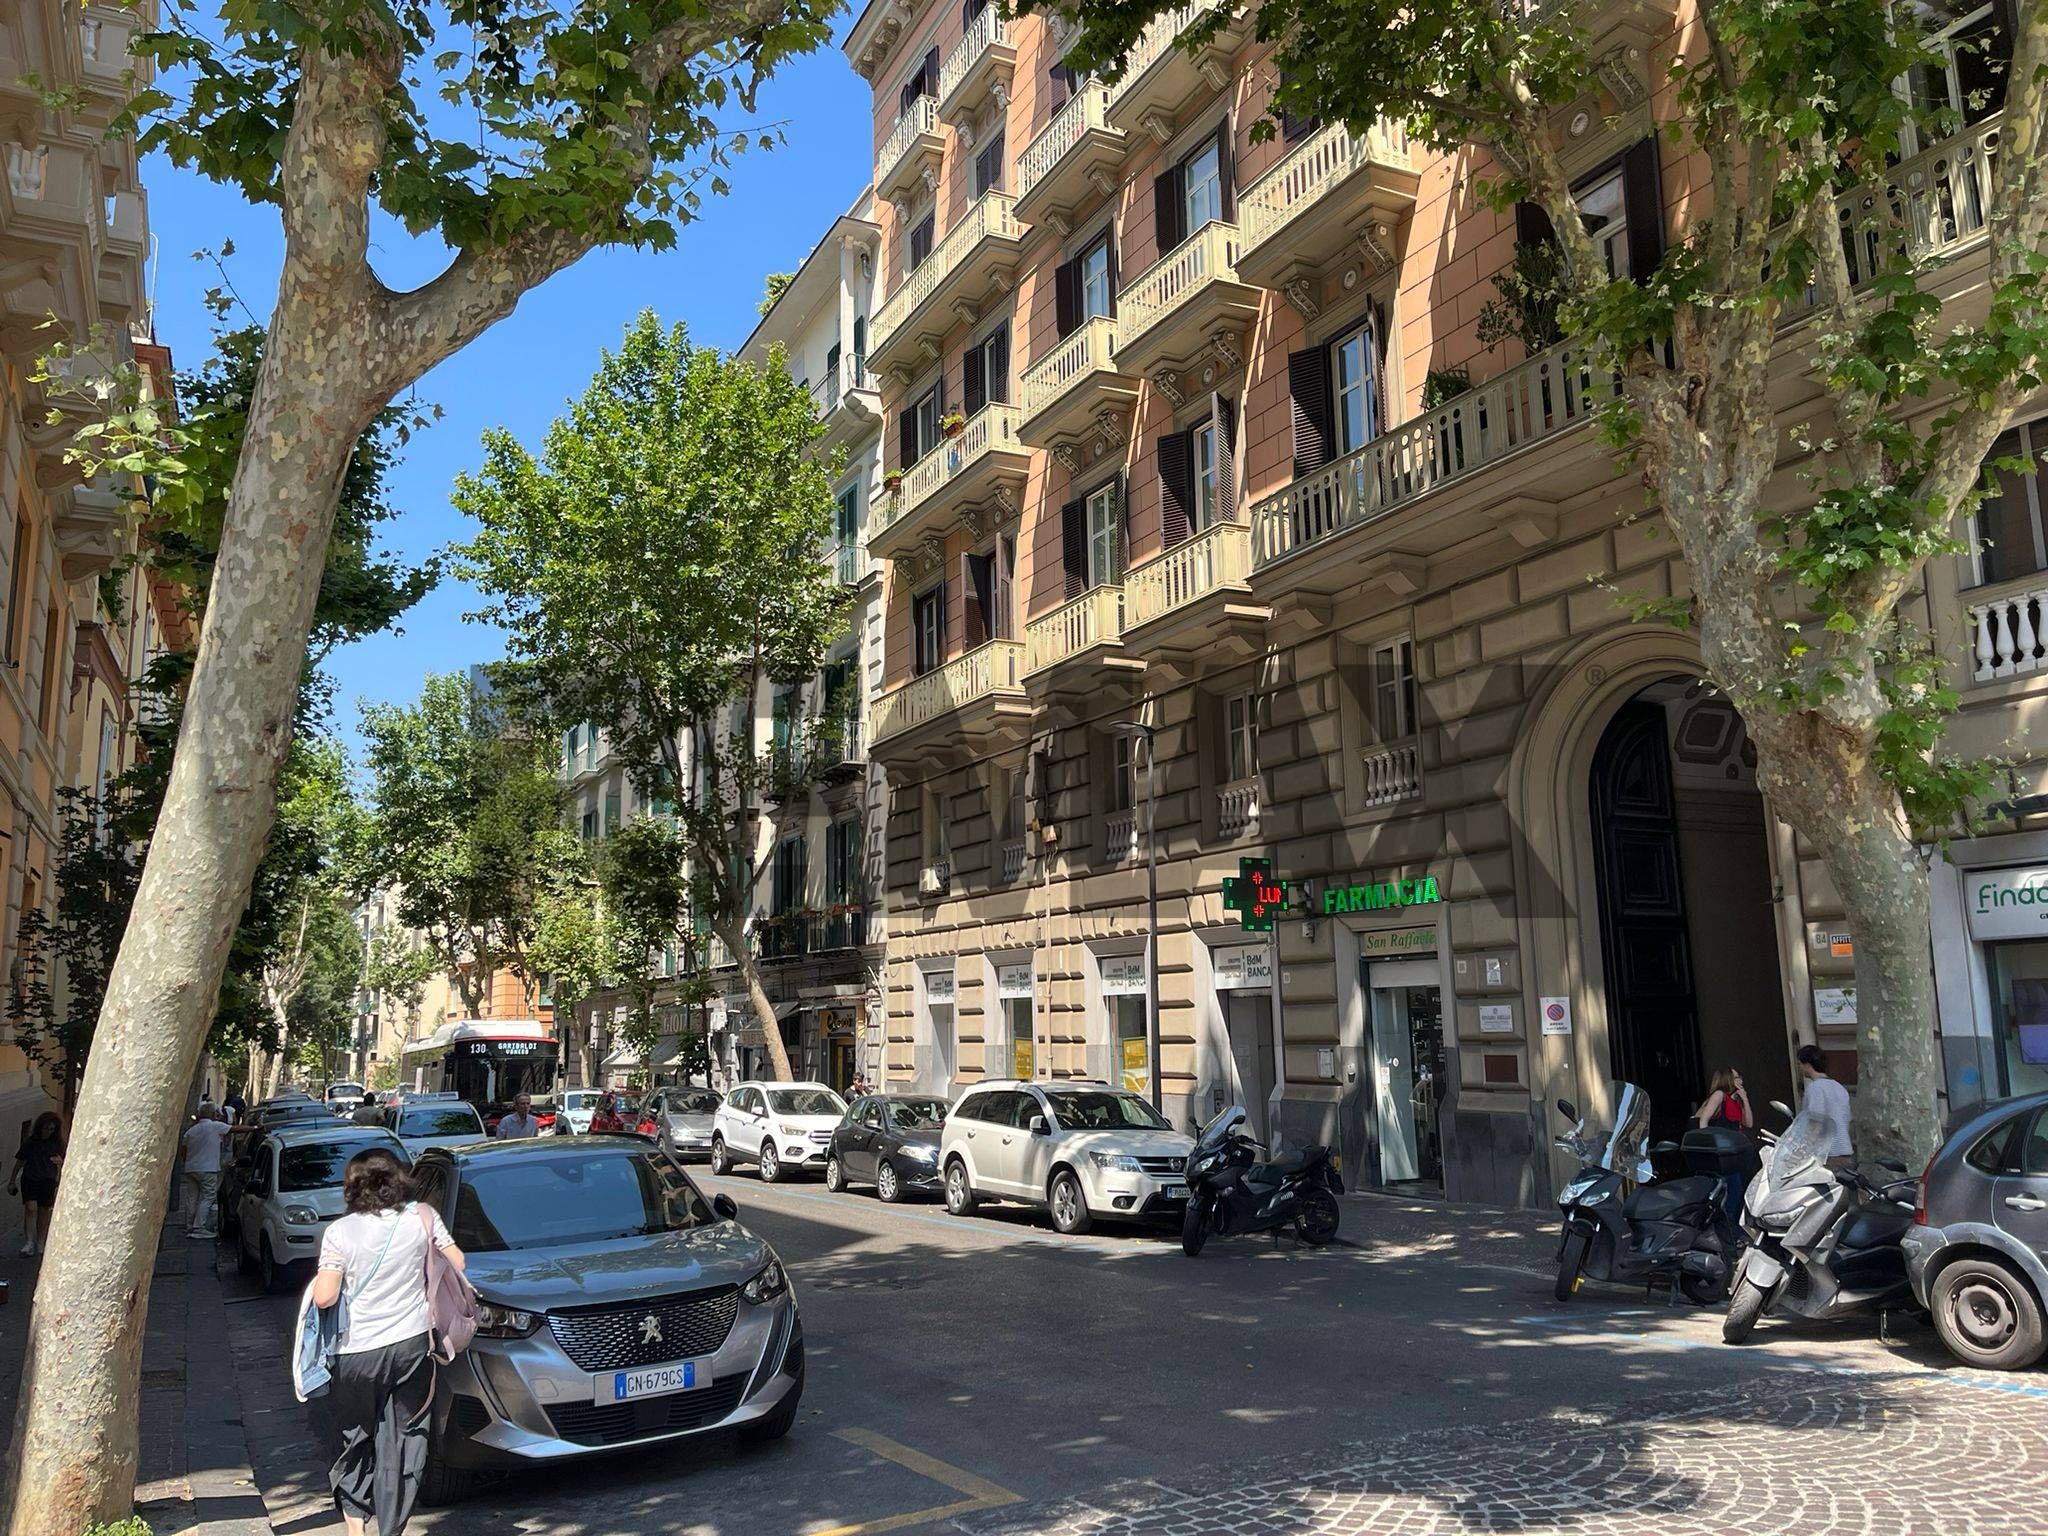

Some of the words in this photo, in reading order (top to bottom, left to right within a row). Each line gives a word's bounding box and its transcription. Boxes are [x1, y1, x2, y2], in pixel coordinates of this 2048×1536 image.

[1323, 876, 1440, 914] FARMACIA
[1366, 934, 1387, 949] San
[1390, 929, 1436, 949] Raffaele
[1246, 954, 1262, 966] BdM
[1247, 966, 1272, 978] BANCA
[470, 1043, 487, 1054] 130
[497, 1042, 538, 1050] GARIBALDI
